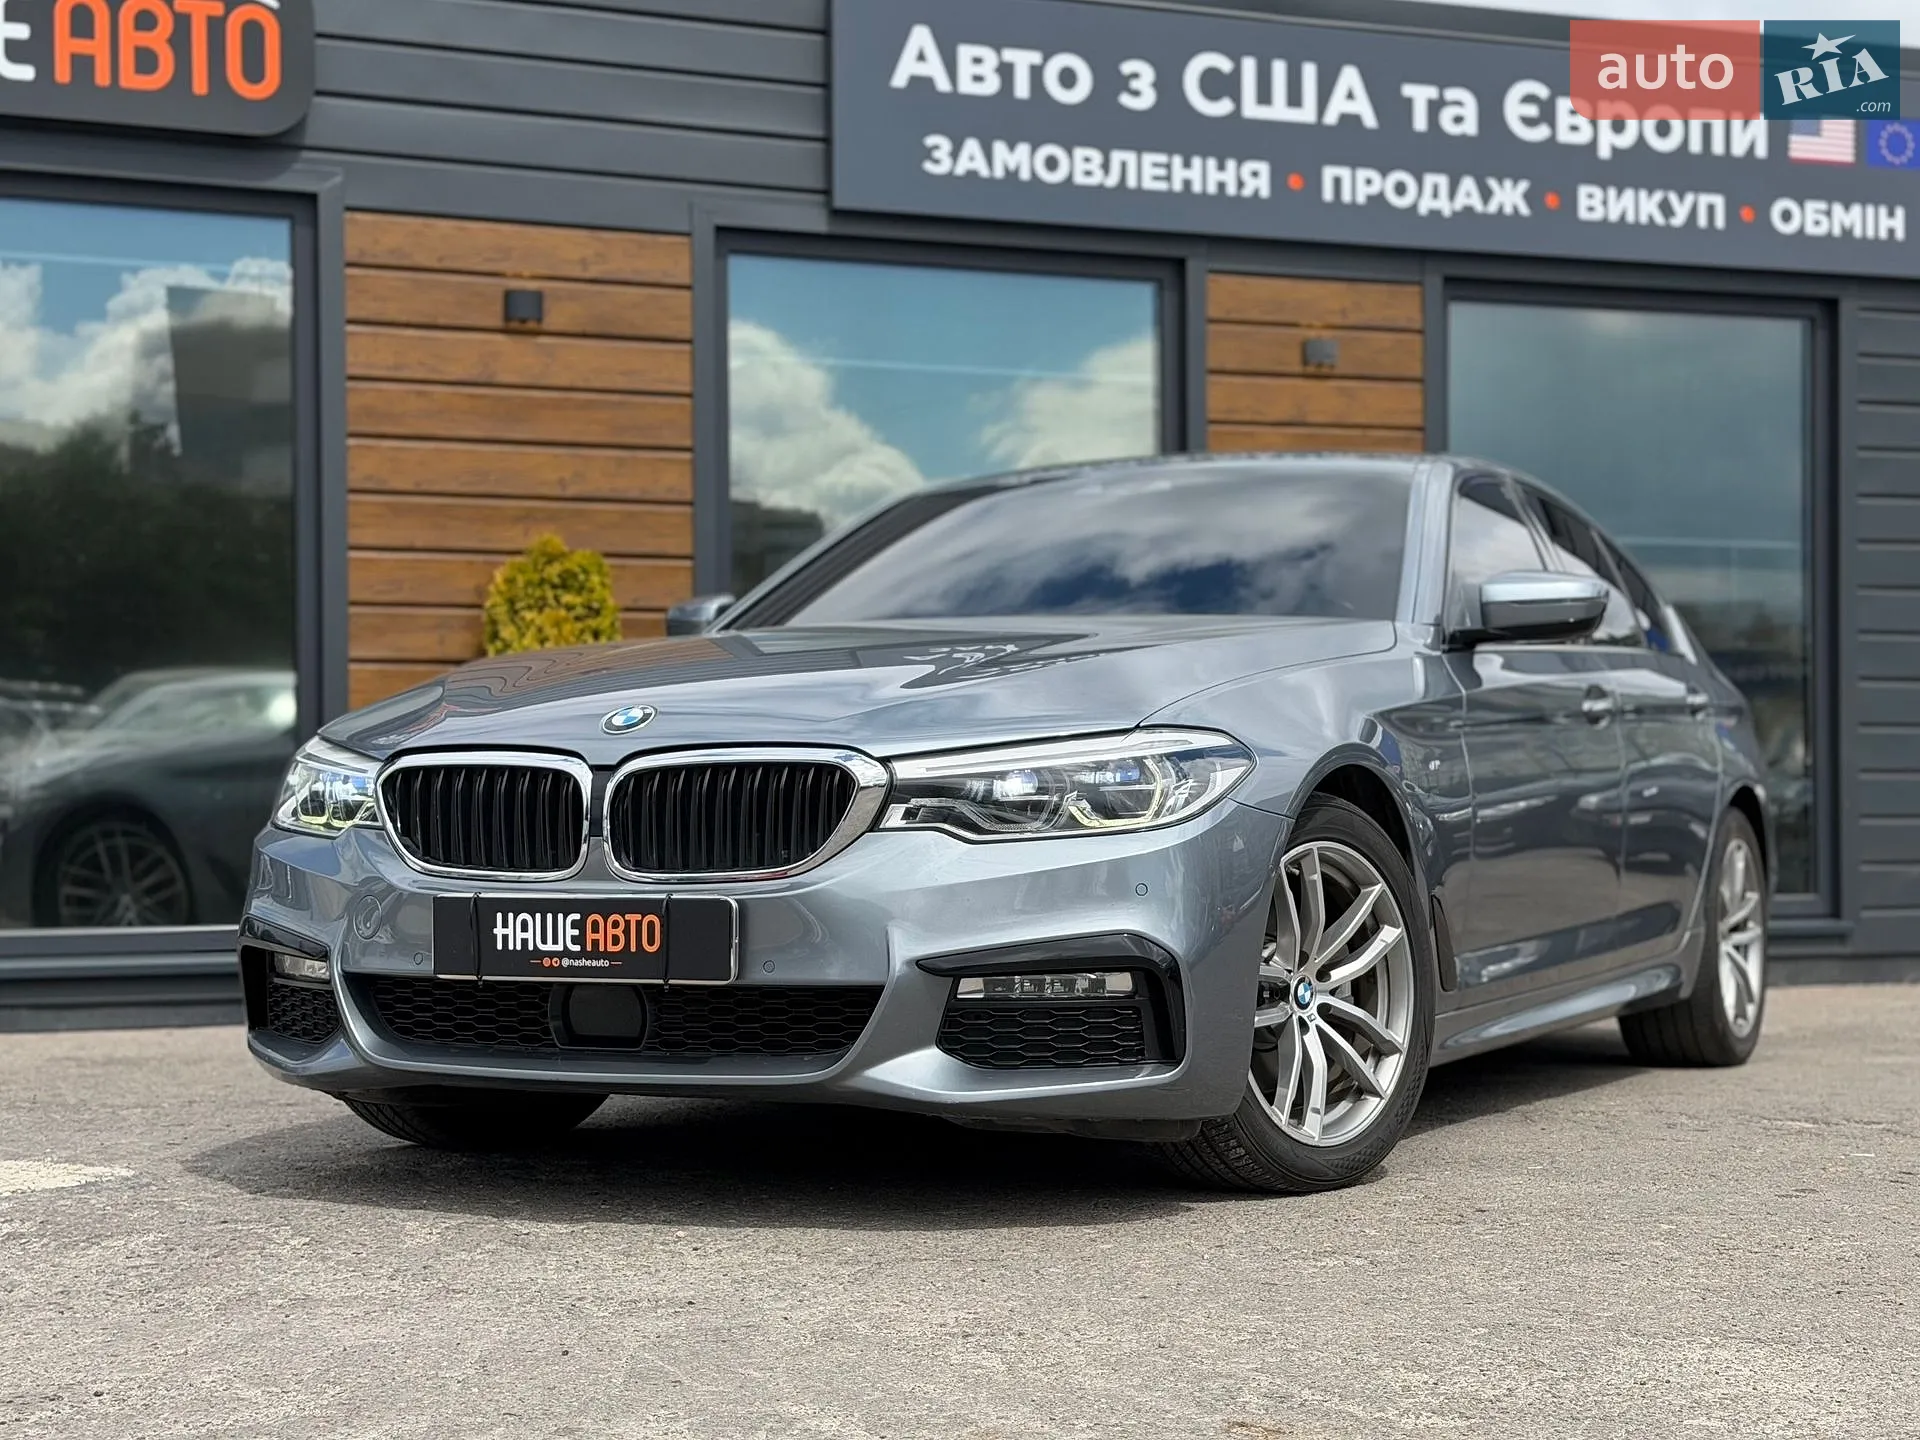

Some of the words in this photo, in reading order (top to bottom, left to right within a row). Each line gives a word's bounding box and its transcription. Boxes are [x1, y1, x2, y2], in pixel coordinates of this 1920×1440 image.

[54, 0, 281, 101] АВТО
[889, 24, 1094, 105] Авто
[1118, 59, 1157, 111] з
[1183, 51, 1379, 129] США
[1401, 82, 1480, 136] та
[1503, 79, 1768, 160] Європи
[922, 134, 1271, 199] ЗАМОВЛЕННЯ
[1321, 165, 1531, 218] ПРОДАЖ
[1577, 184, 1726, 230] ВИКУП
[1770, 197, 1906, 241] ОБМІН
[493, 912, 581, 952] НАШЕ
[585, 913, 661, 953] АВТО
[561, 957, 609, 968] @nasheauto
